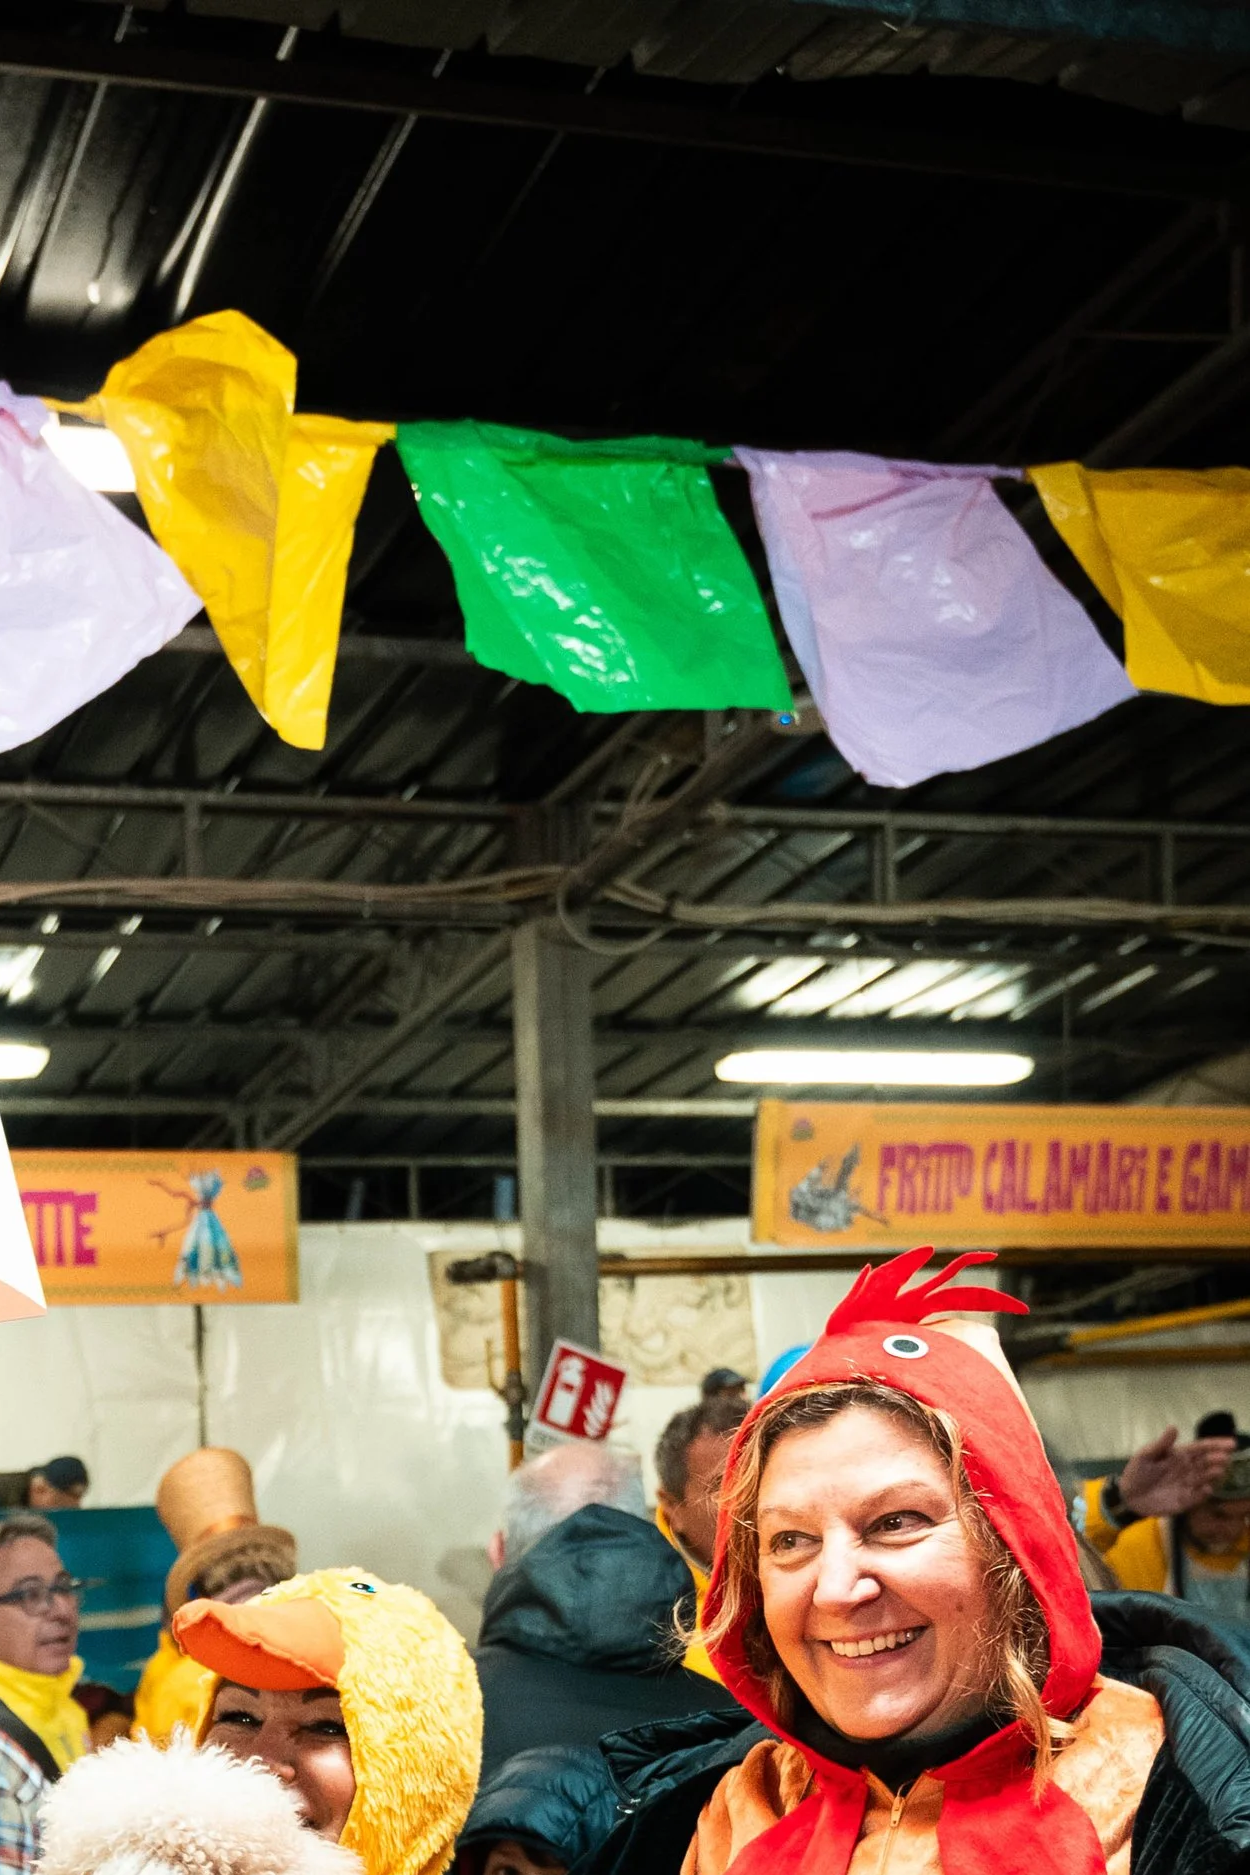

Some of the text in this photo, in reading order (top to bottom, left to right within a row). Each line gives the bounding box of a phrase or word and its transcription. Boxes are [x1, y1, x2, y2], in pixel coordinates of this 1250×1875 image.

[983, 1139, 1148, 1215] CALAMARI
[1156, 1146, 1173, 1213] E
[21, 1191, 97, 1267] TTE
